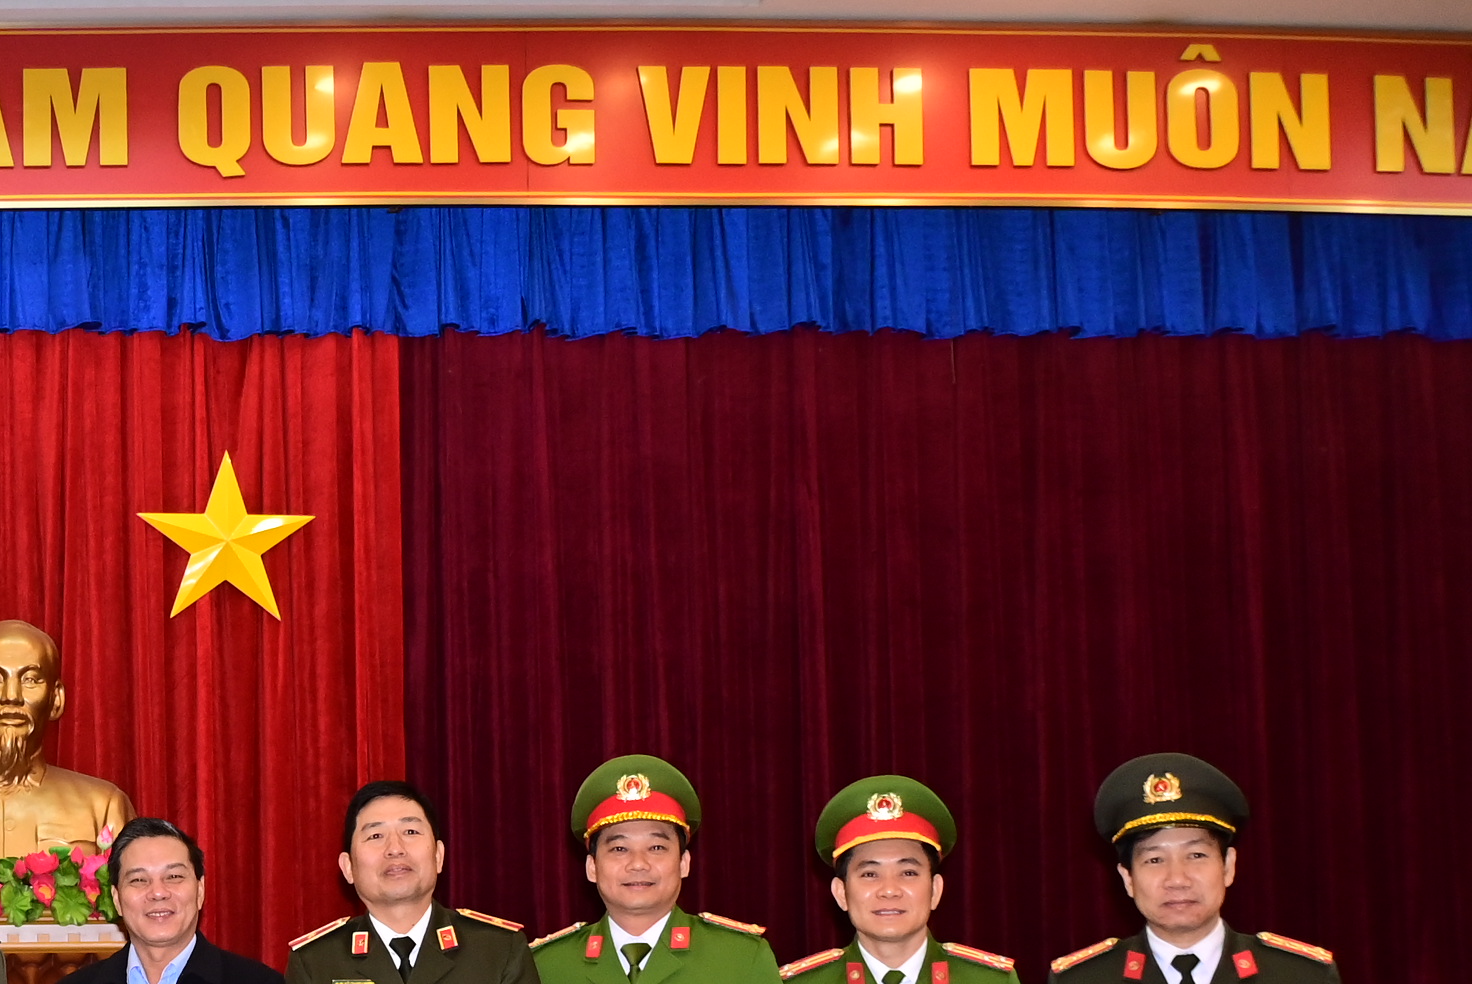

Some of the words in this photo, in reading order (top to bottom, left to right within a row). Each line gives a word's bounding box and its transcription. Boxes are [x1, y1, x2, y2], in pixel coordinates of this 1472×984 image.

[177, 62, 597, 178] QUANG
[638, 65, 925, 167] VINH
[968, 43, 1332, 171] MUÔN
[1373, 72, 1472, 176] N
